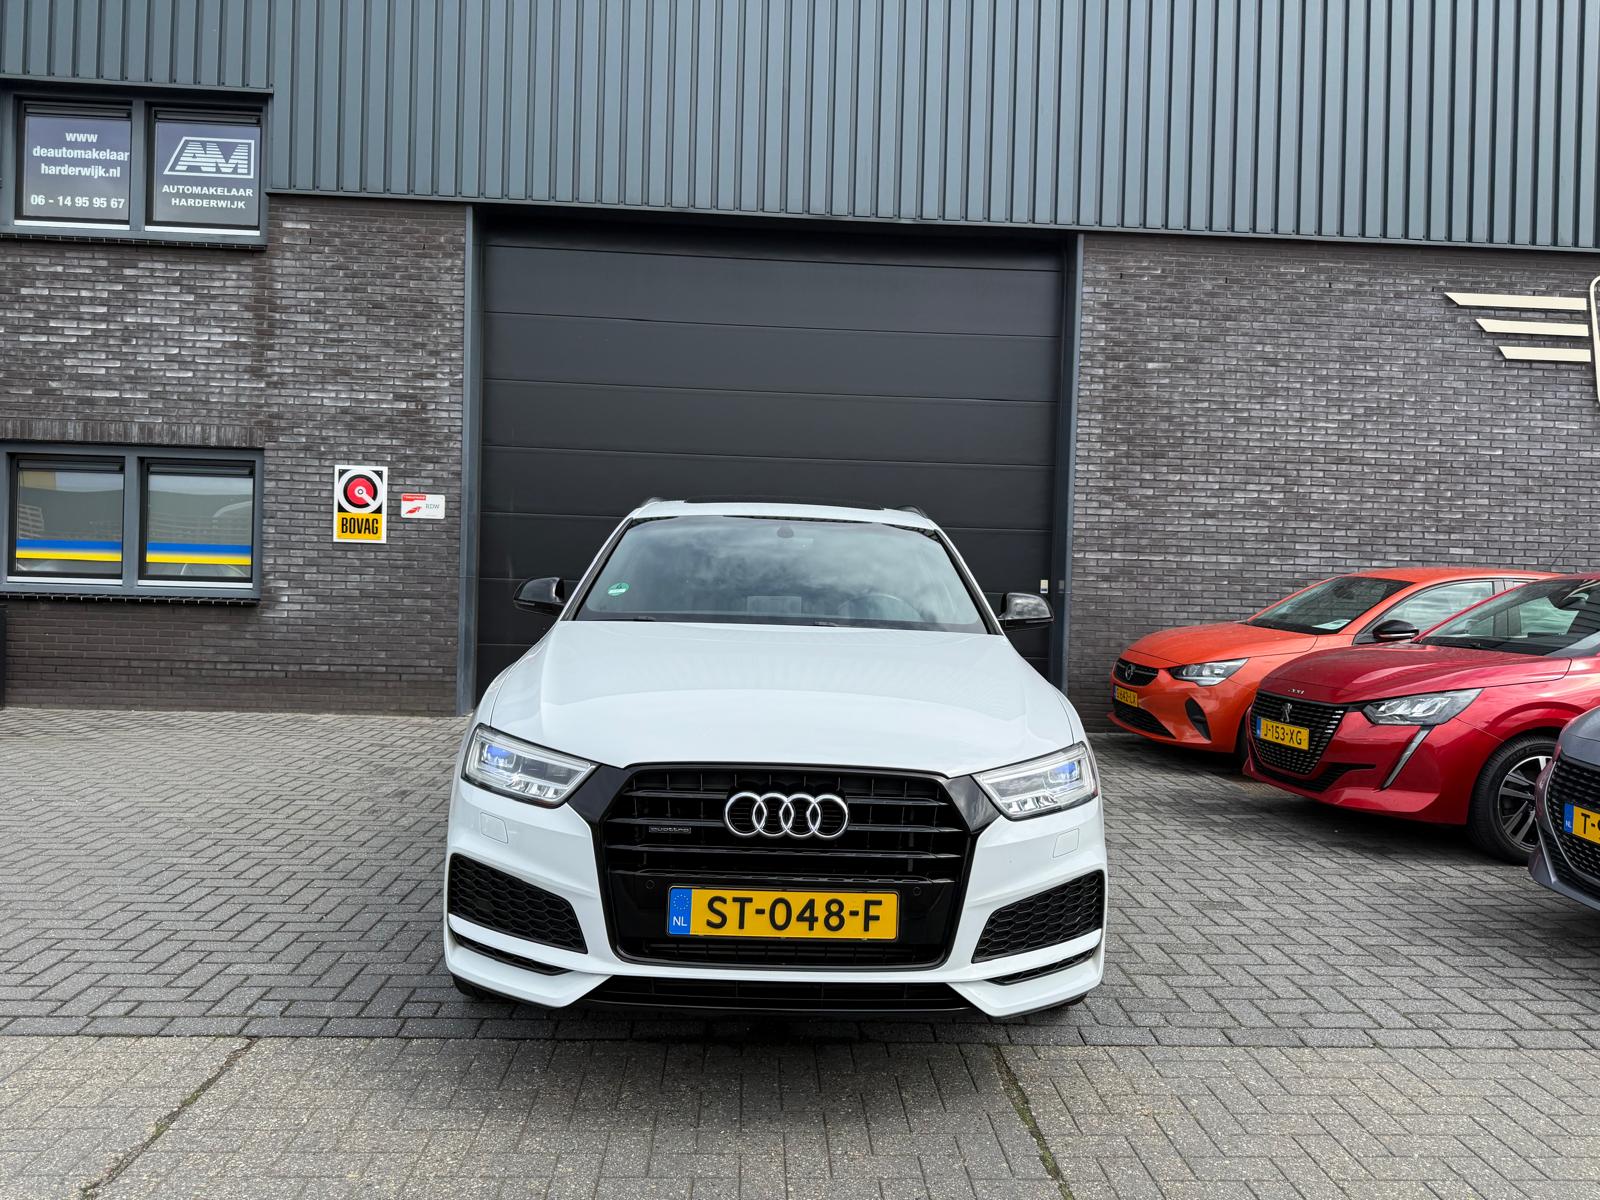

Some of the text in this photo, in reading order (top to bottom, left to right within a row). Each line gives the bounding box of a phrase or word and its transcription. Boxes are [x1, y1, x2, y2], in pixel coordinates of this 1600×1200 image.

[65, 132, 98, 143] www
[32, 145, 130, 161] deautomakelaar
[174, 141, 249, 174] AM
[40, 163, 121, 179] harderwijk.nl
[162, 184, 254, 197] AUTOMAKELAAR
[30, 194, 46, 206] 06
[58, 195, 72, 207] 14
[74, 196, 89, 207] 95
[92, 197, 107, 208] 95
[110, 198, 125, 209] 67
[171, 197, 246, 209] HARDERWIJK
[341, 517, 379, 535] BOVAG
[1264, 722, 1302, 745] J-153-XG
[1581, 812, 1600, 835] T-
[672, 916, 688, 926] NL
[705, 895, 883, 932] ST-048-F
